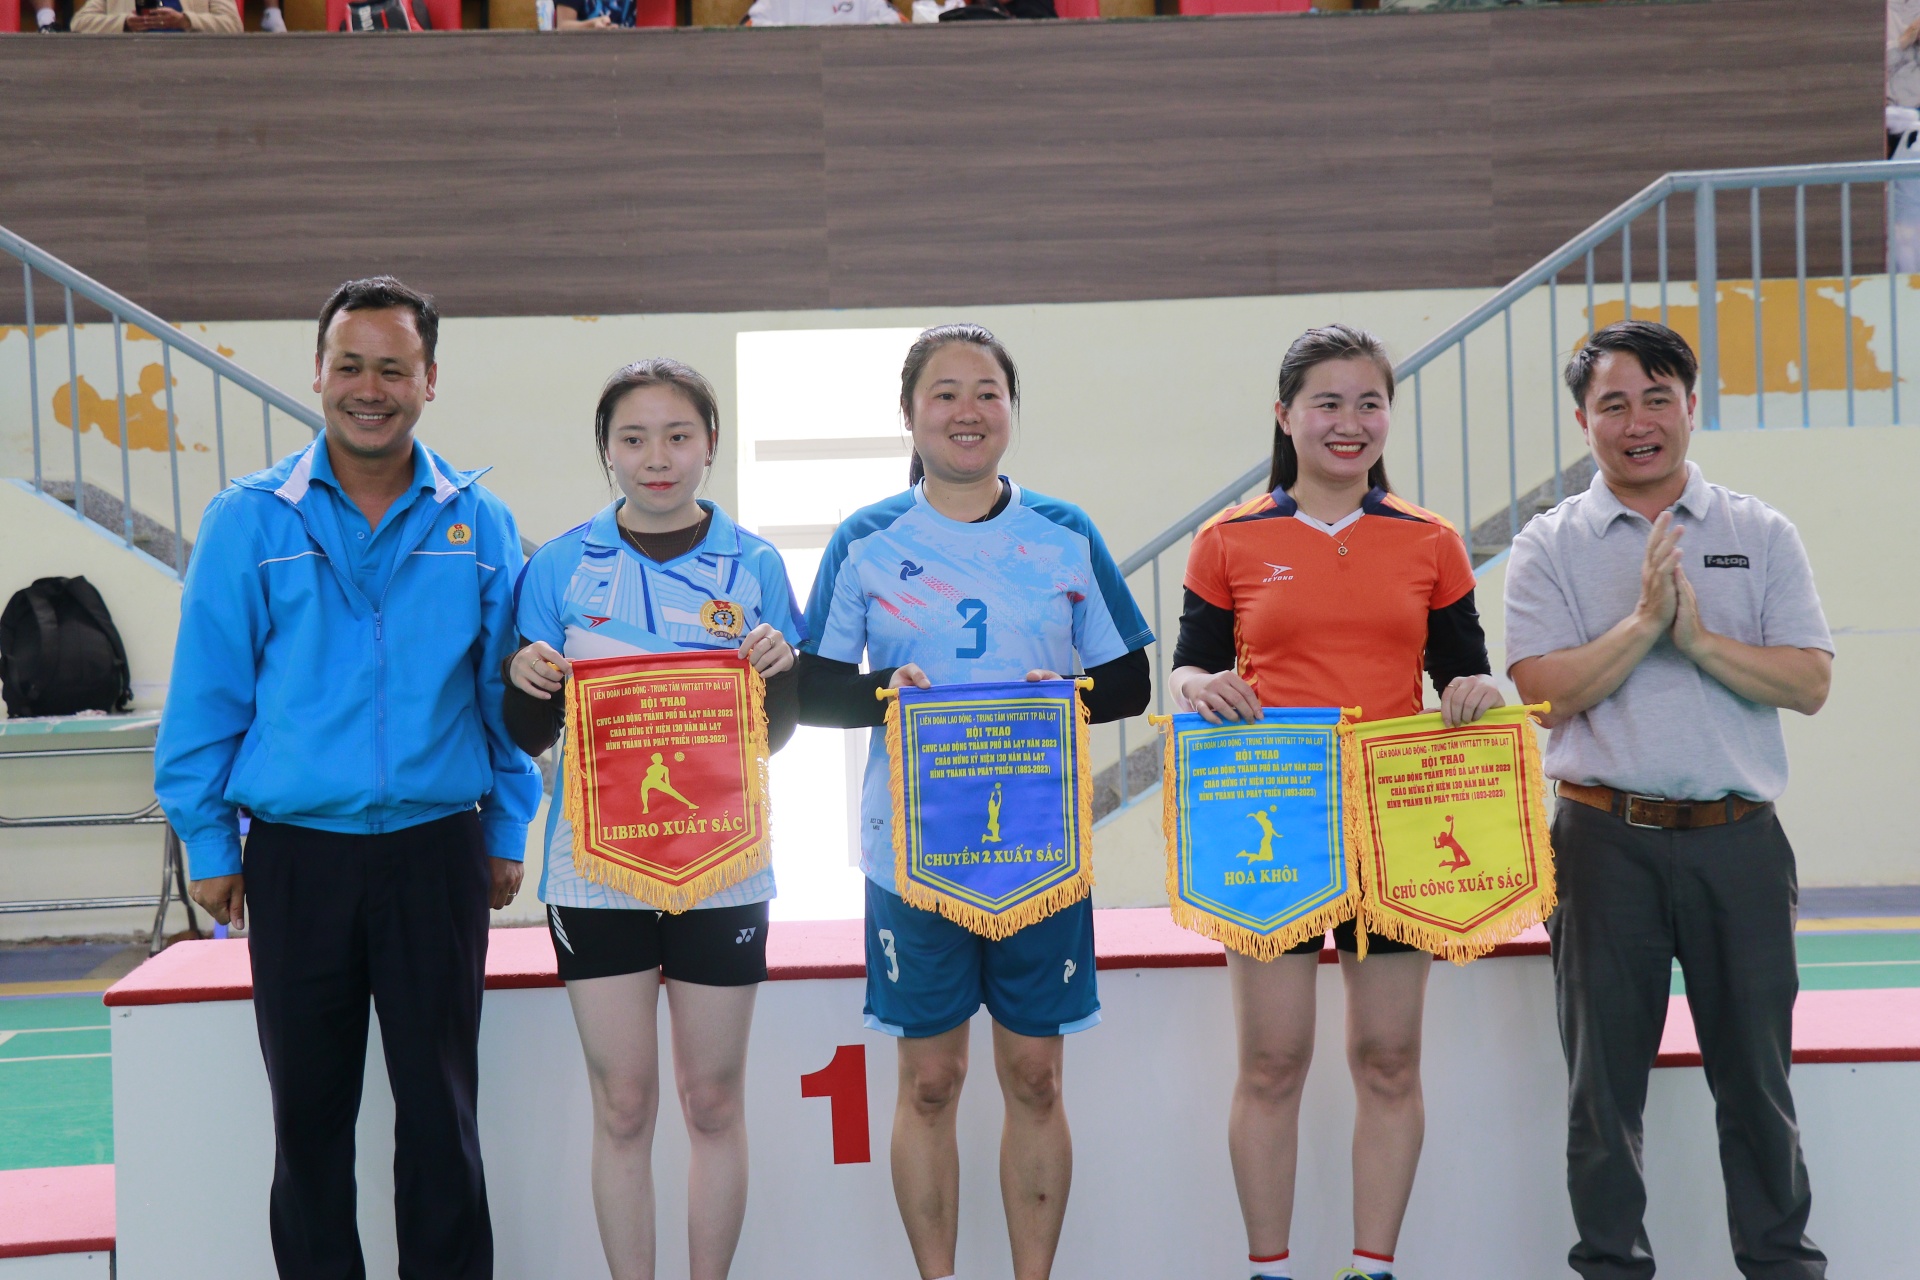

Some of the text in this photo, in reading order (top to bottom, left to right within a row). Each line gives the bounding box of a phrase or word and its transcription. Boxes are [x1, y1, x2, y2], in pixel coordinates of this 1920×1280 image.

[956, 598, 987, 659] 3
[594, 691, 605, 700] LIÊN
[607, 688, 620, 698] ĐOÀN
[622, 686, 631, 696] LAO
[633, 684, 646, 696] ĐỘNG
[651, 683, 667, 693] TRUNG
[669, 682, 680, 691] TÂM
[681, 682, 704, 691] VHTT&TT
[722, 682, 731, 692] LẠT
[641, 696, 686, 710] HỘI THAO
[597, 718, 611, 726] CNVC
[613, 715, 624, 724] LAO
[626, 712, 641, 724] ĐỘNG
[665, 708, 677, 719] PHỐ
[689, 710, 701, 719] LẠT
[718, 709, 733, 717] 2023
[948, 715, 958, 724] LAO
[610, 726, 626, 737] CHÀO
[656, 722, 670, 733] NIỆM
[673, 724, 682, 732] 130
[709, 722, 721, 732] LẠT
[966, 726, 1011, 739] HỘI THAO
[606, 741, 620, 750] HÌNH
[653, 736, 669, 746] PHÁT
[692, 735, 728, 745] (1893-2023)
[939, 743, 950, 752] LAO
[1042, 739, 1056, 747] 2023
[1402, 747, 1412, 755] LAO
[1235, 749, 1279, 763] HỘI THAO
[1422, 754, 1465, 768] HỘI THAO
[1394, 774, 1405, 783] LAO
[1496, 764, 1510, 772] 2023
[603, 810, 743, 840] LIBERO XUẤT SẮC
[924, 843, 1063, 866] CHUYỀN 2 XUẤT SẮC
[1224, 865, 1298, 885] HOA KHÔI
[1393, 868, 1522, 899] CHỦ CÔNG XUẤT SẮC
[879, 928, 899, 983] 3
[801, 1044, 871, 1164] 1
